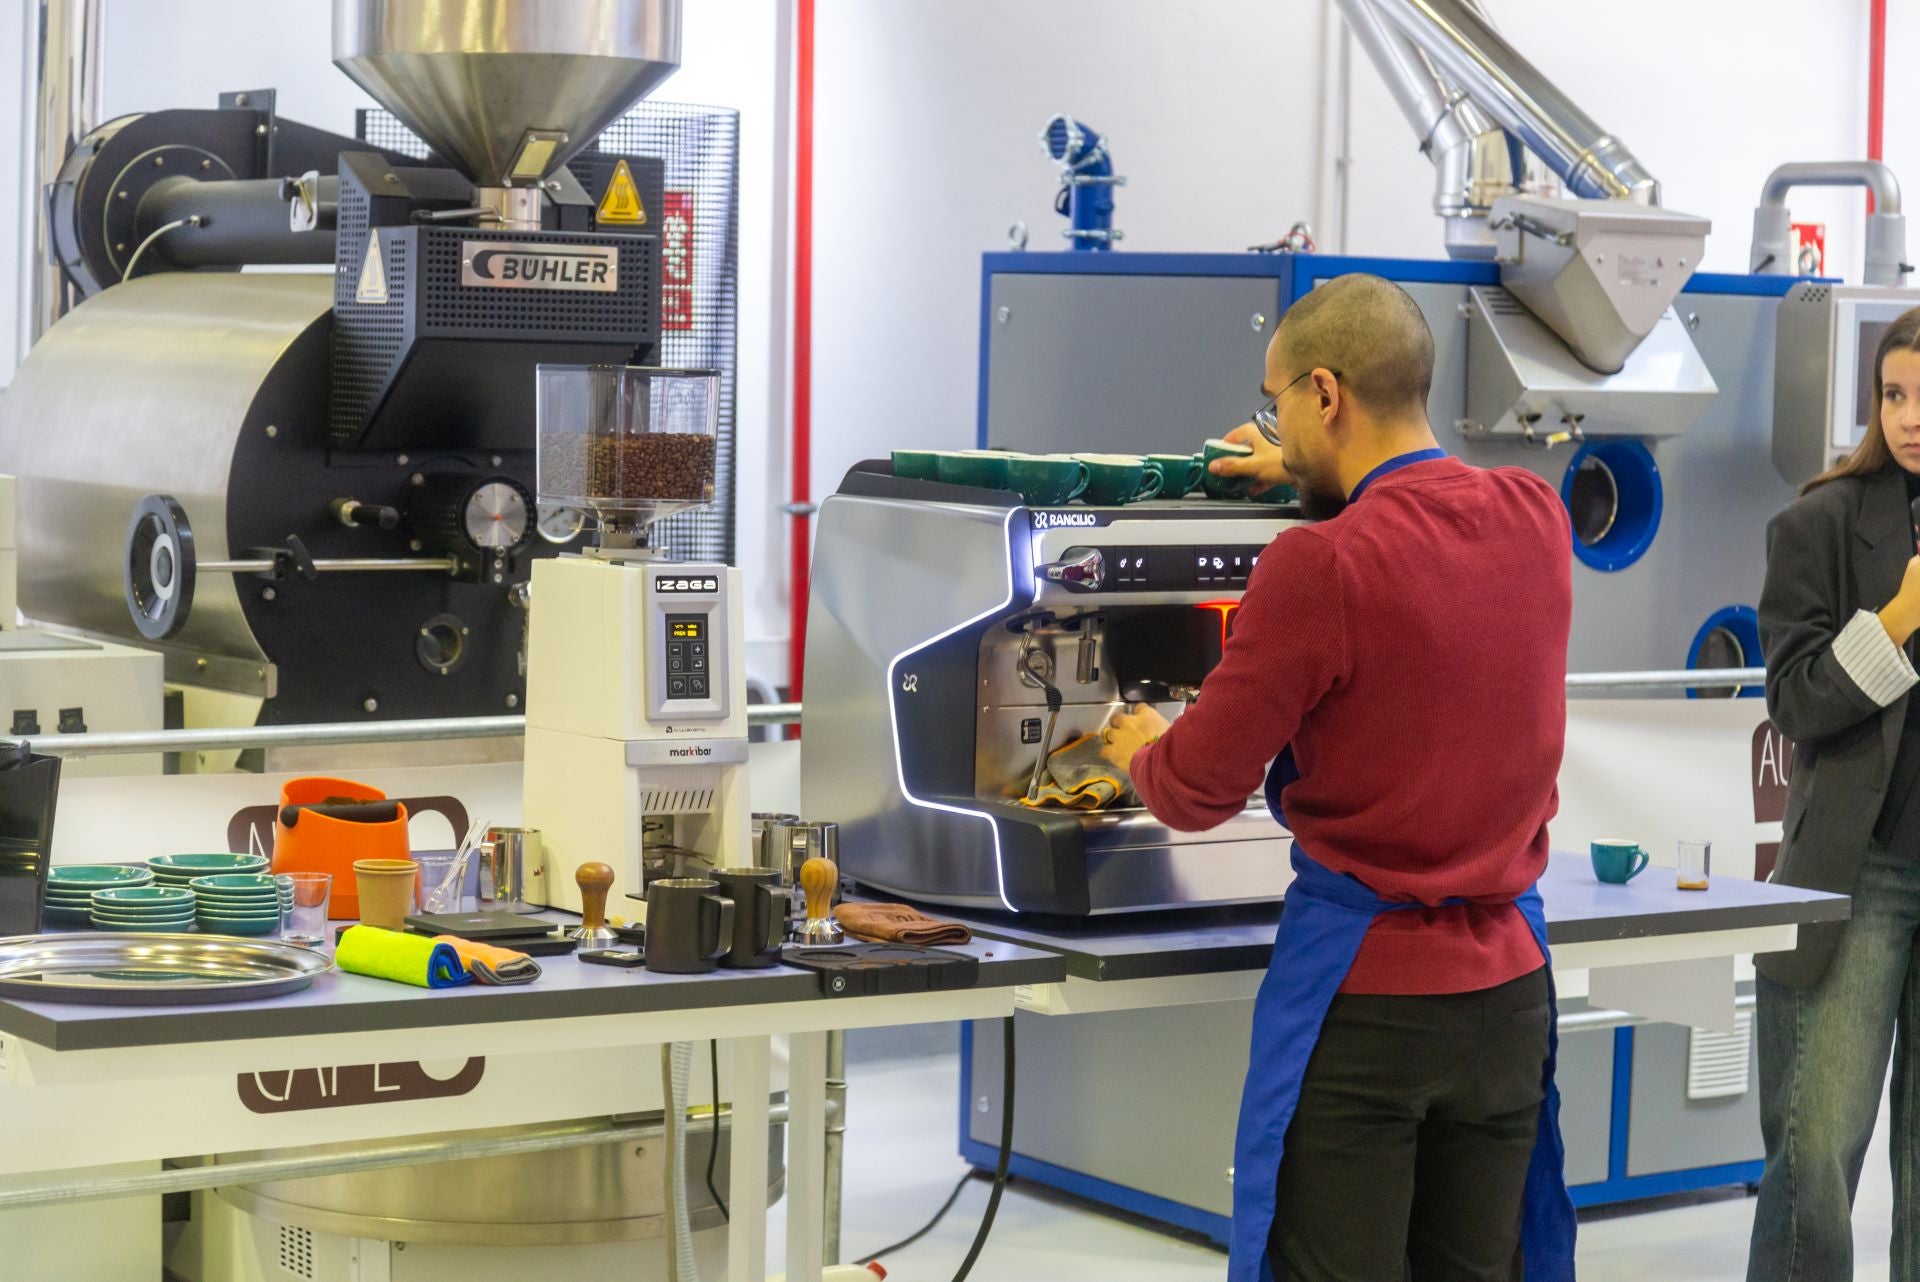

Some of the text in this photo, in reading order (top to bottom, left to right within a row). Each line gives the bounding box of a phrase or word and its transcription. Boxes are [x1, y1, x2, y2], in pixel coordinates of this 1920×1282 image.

[502, 257, 608, 284] BÜHLER
[1049, 513, 1096, 527] RANCILIO
[669, 745, 712, 757] markibar
